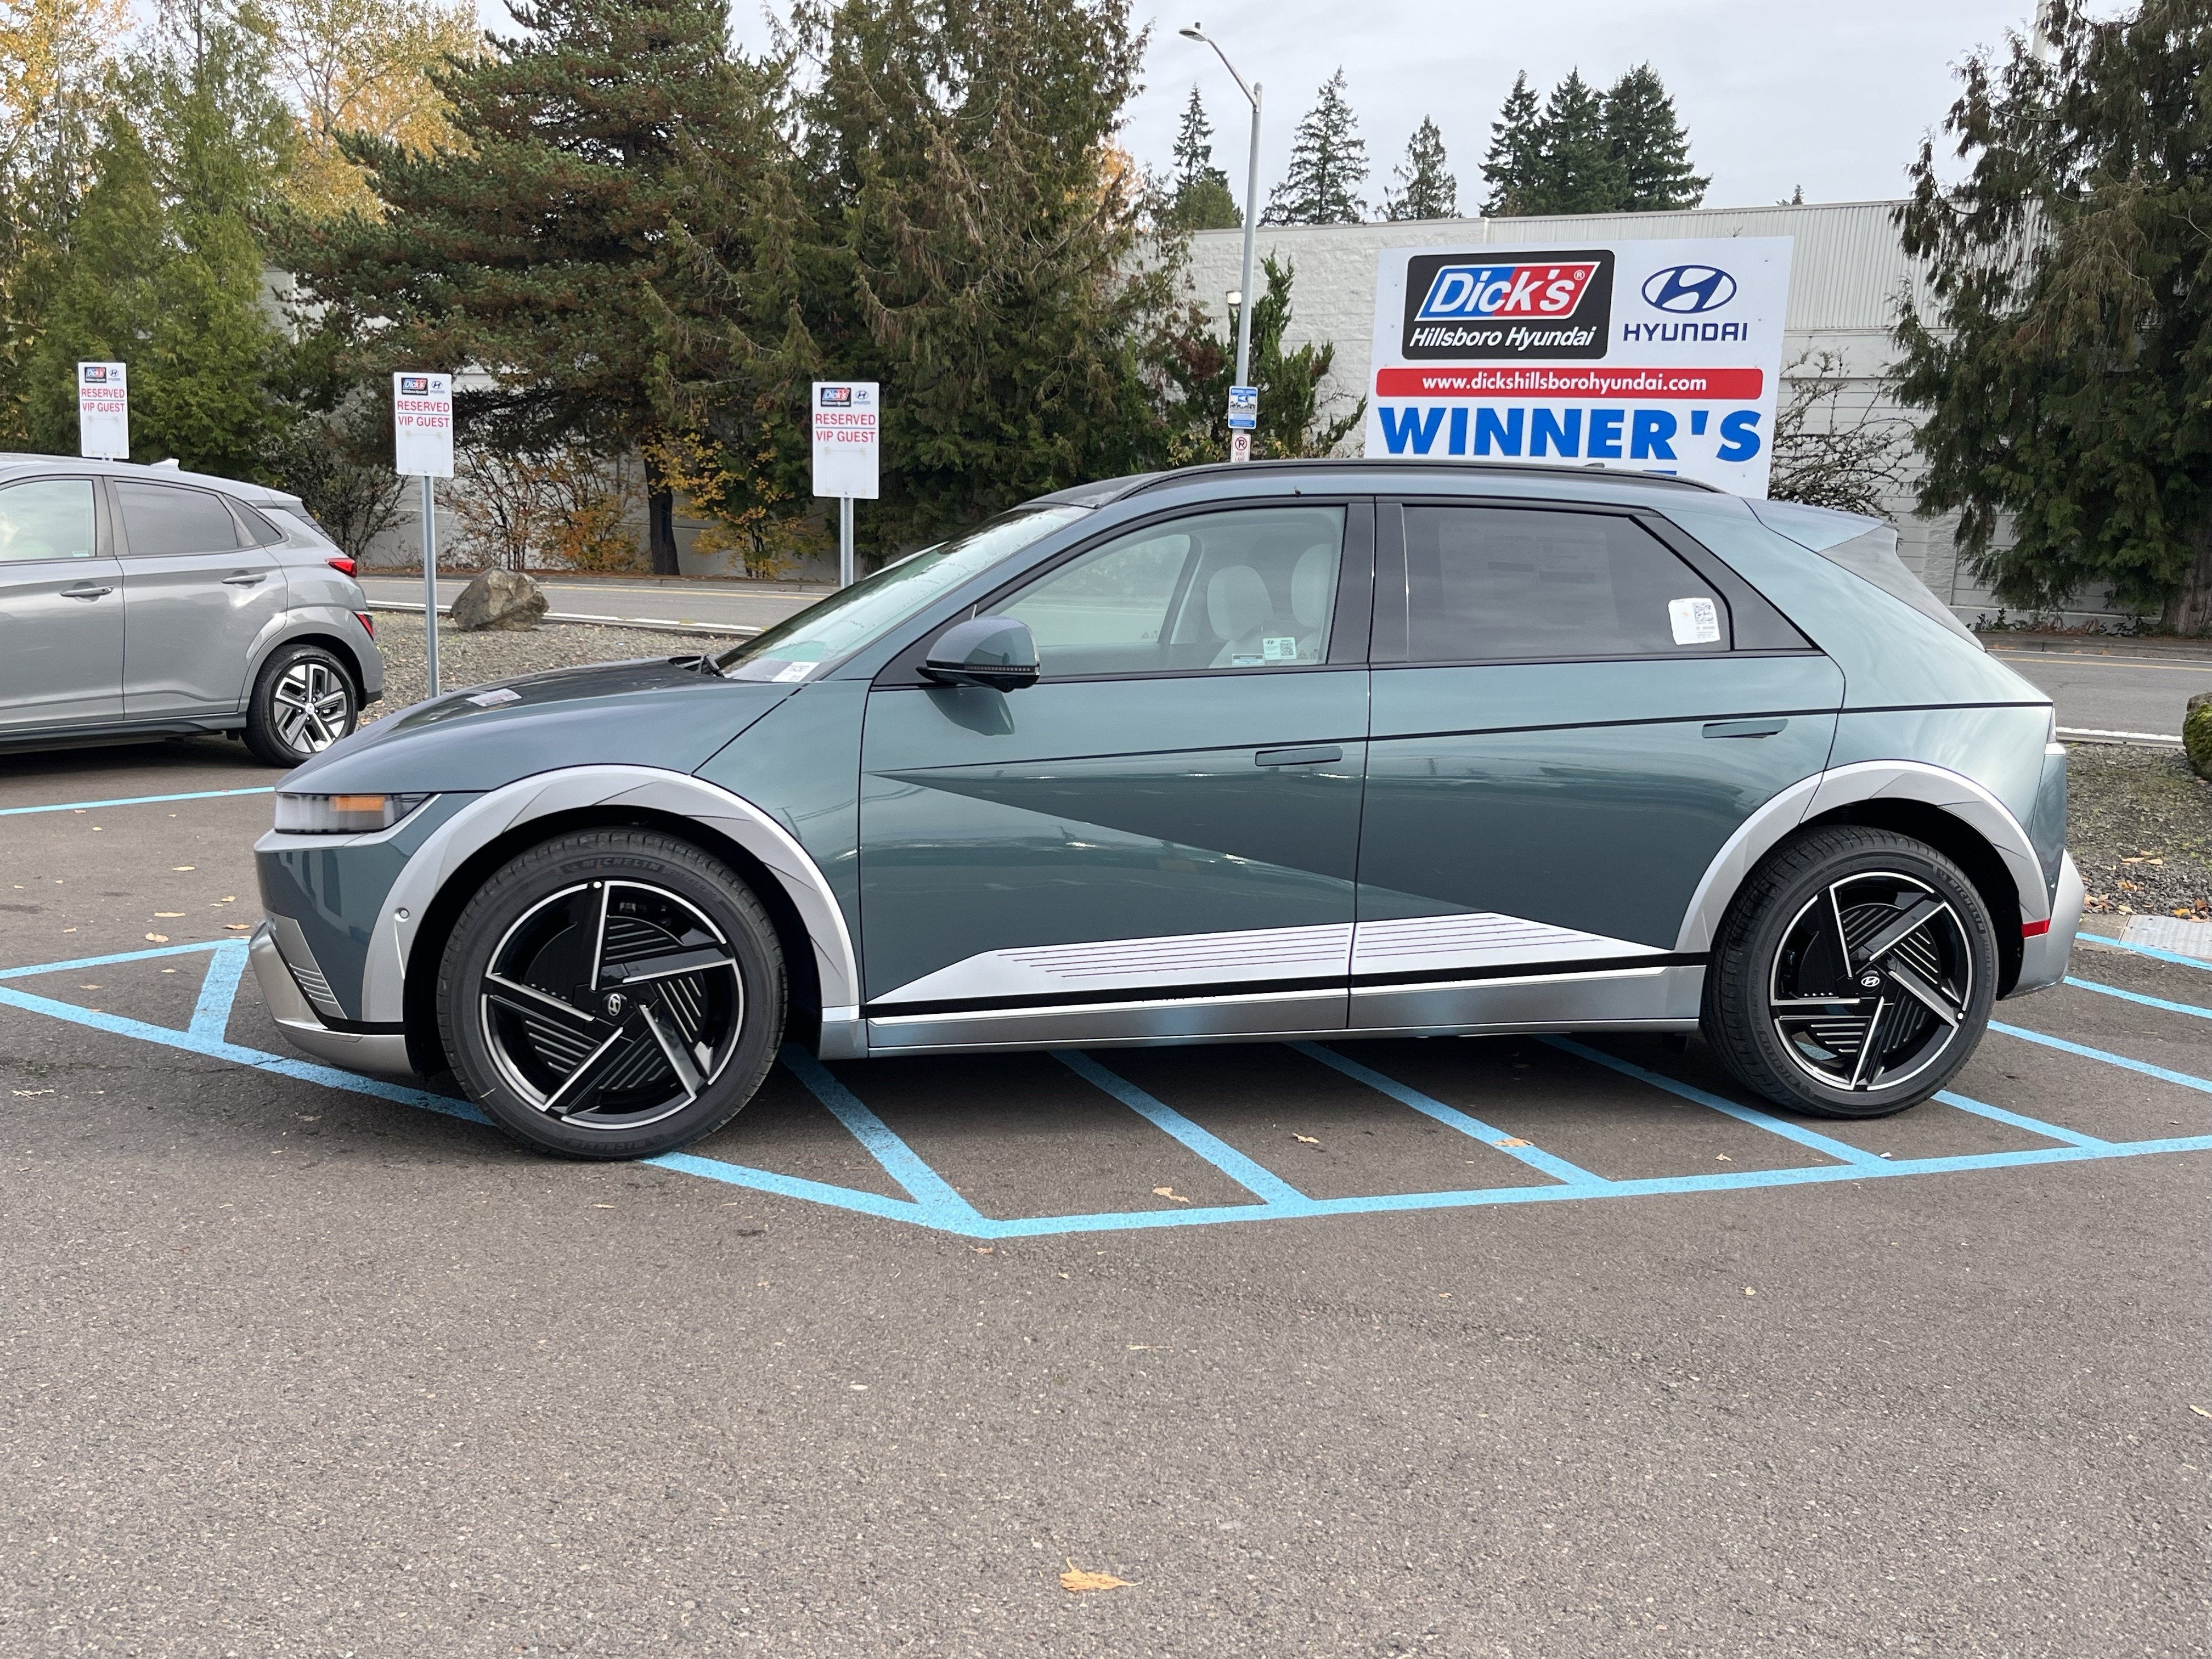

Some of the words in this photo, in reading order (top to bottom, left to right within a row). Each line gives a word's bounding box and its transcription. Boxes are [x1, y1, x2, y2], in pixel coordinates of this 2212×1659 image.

[1409, 326, 1503, 347] Hillsboro
[1505, 326, 1597, 351] Hyundai
[1623, 323, 1748, 342] HYUNDAI
[1422, 371, 1707, 394] www.dickshillsborohyundai.com
[81, 388, 125, 398] RESERVED
[82, 402, 95, 411] VIP
[97, 402, 125, 412] GUEST
[397, 400, 450, 412] RESERVED
[398, 415, 414, 426] VIP
[416, 416, 450, 427] GUEST
[815, 413, 876, 425] RESERVED
[816, 430, 833, 442] VIP
[837, 431, 876, 443] GUEST
[1378, 407, 1762, 462] WINNER'S
[582, 857, 661, 871] MICHELIN
[1948, 878, 1985, 931] MICHELIN
[1759, 1033, 1797, 1086] MICHELIN
